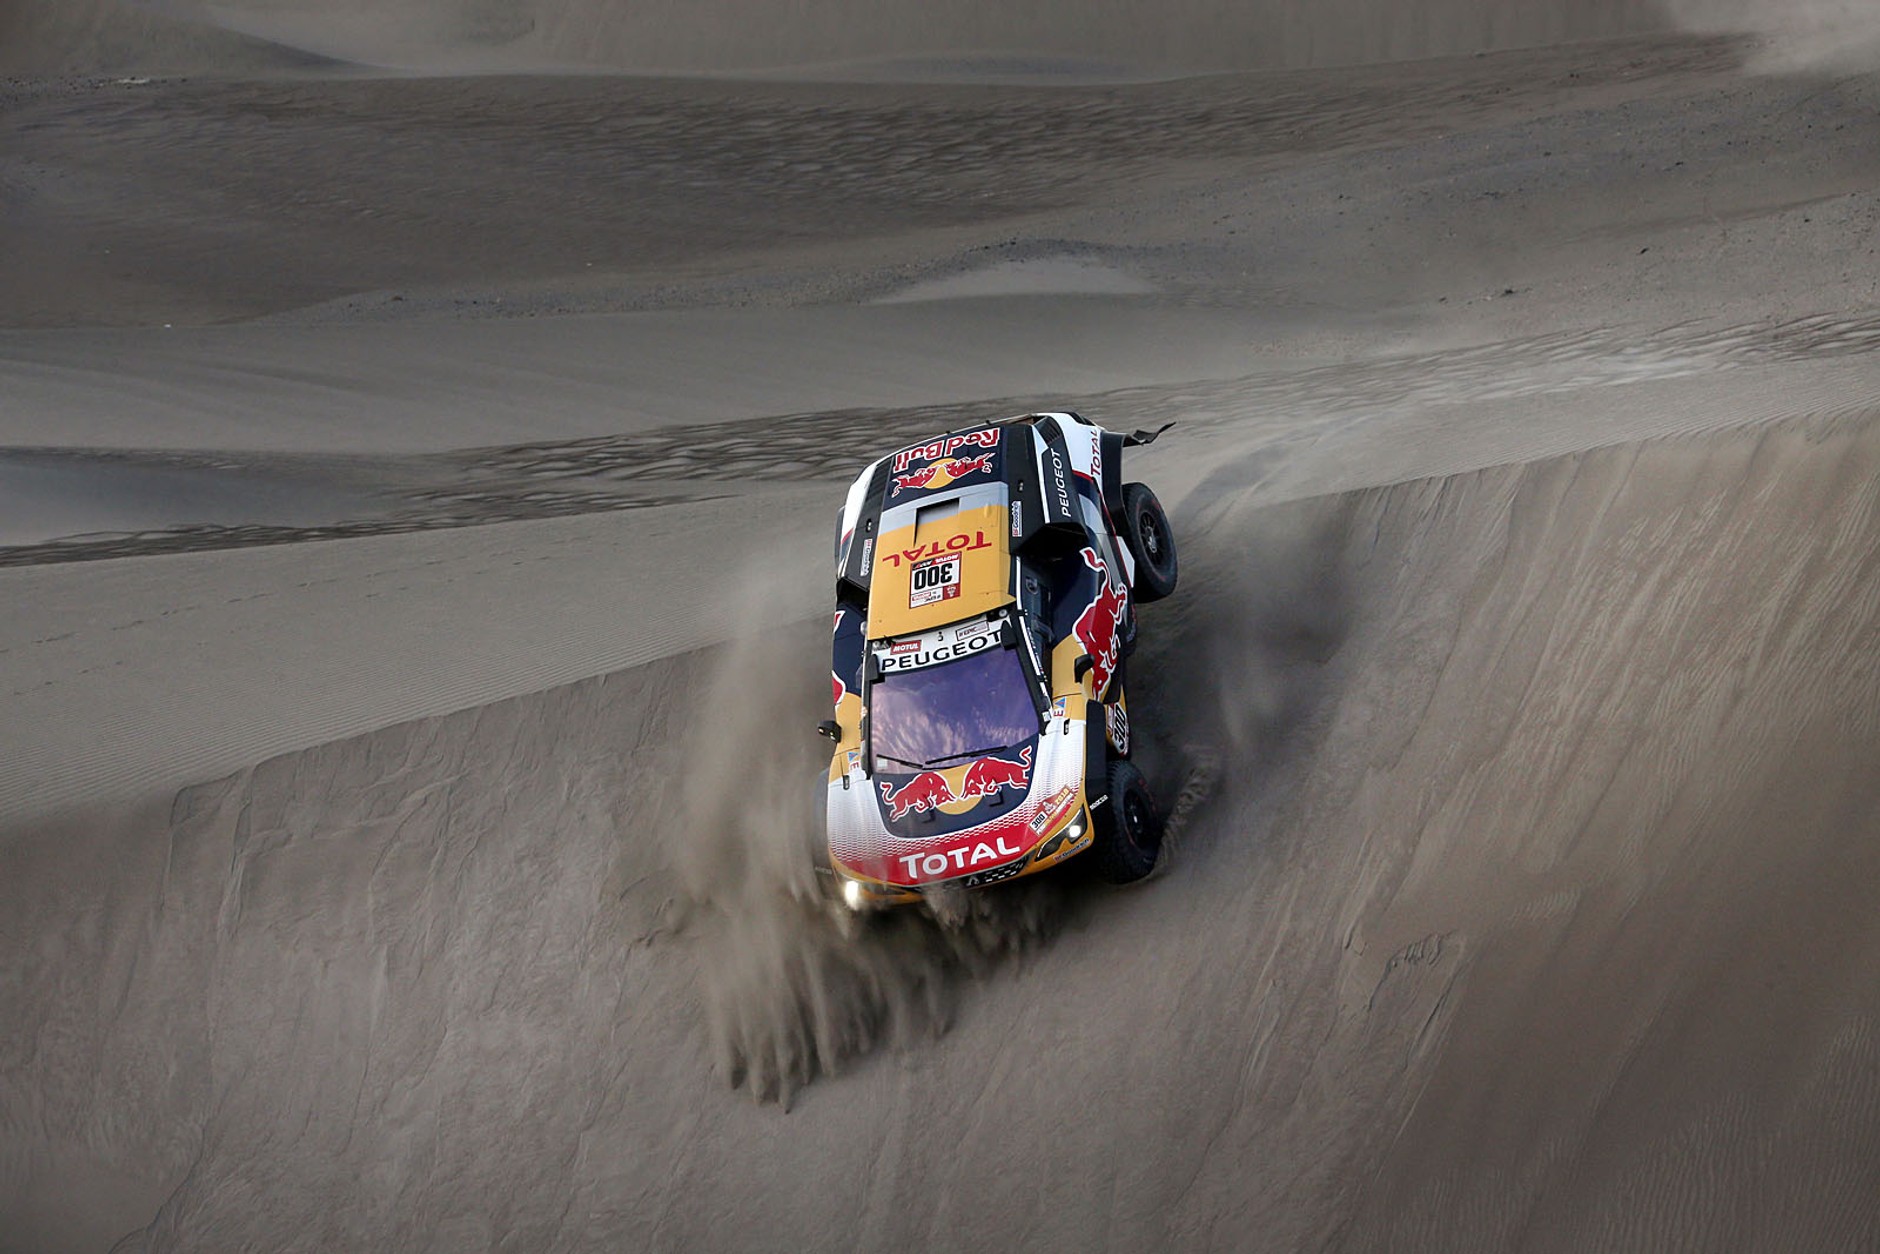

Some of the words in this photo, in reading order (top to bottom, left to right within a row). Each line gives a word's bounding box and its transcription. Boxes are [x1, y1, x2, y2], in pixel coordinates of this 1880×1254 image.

[893, 439, 945, 474] Bull
[944, 427, 1001, 457] Red
[1090, 429, 1101, 476] TOTAL
[1050, 448, 1072, 518] PEUGEOT
[882, 531, 992, 568] TOTAL
[914, 562, 953, 590] 300
[881, 630, 1002, 671] PEUGEOT
[892, 642, 919, 652] MOTUL
[1114, 705, 1126, 750] 300
[1031, 813, 1046, 829] 300
[899, 836, 1021, 880] TOTAL
